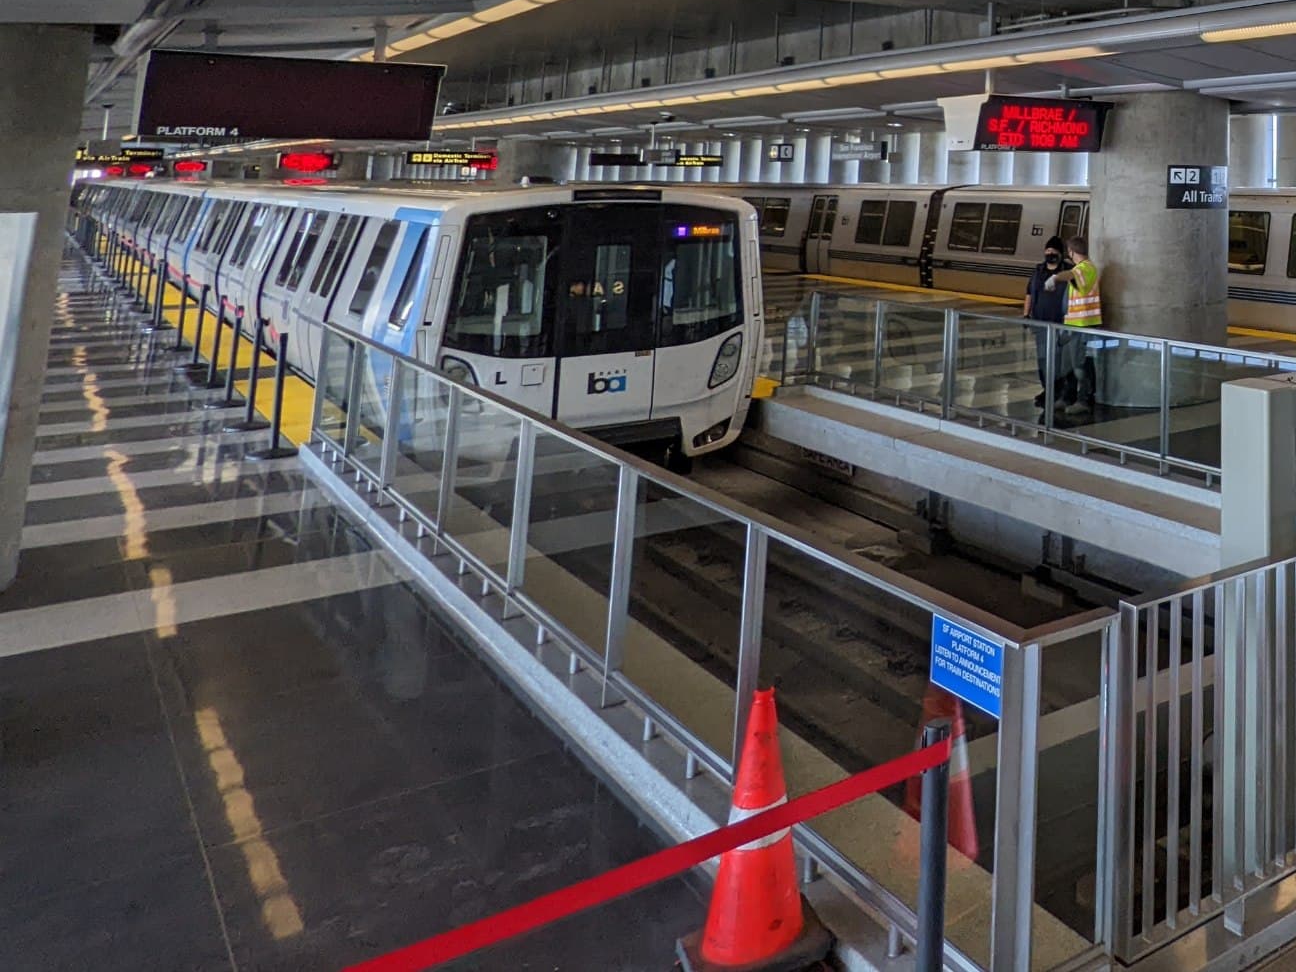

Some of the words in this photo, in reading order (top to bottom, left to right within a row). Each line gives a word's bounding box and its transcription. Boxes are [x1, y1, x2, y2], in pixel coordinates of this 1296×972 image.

[156, 126, 226, 136] PLATFORM
[229, 127, 239, 136] 4
[1189, 170, 1197, 182] 2
[1182, 190, 1198, 203] All
[1199, 190, 1223, 203] Trains
[495, 371, 507, 385] L
[949, 627, 973, 645] AIRPORT
[973, 638, 995, 656] STATION
[935, 656, 946, 669] FOR
[947, 660, 962, 677] TRAIN
